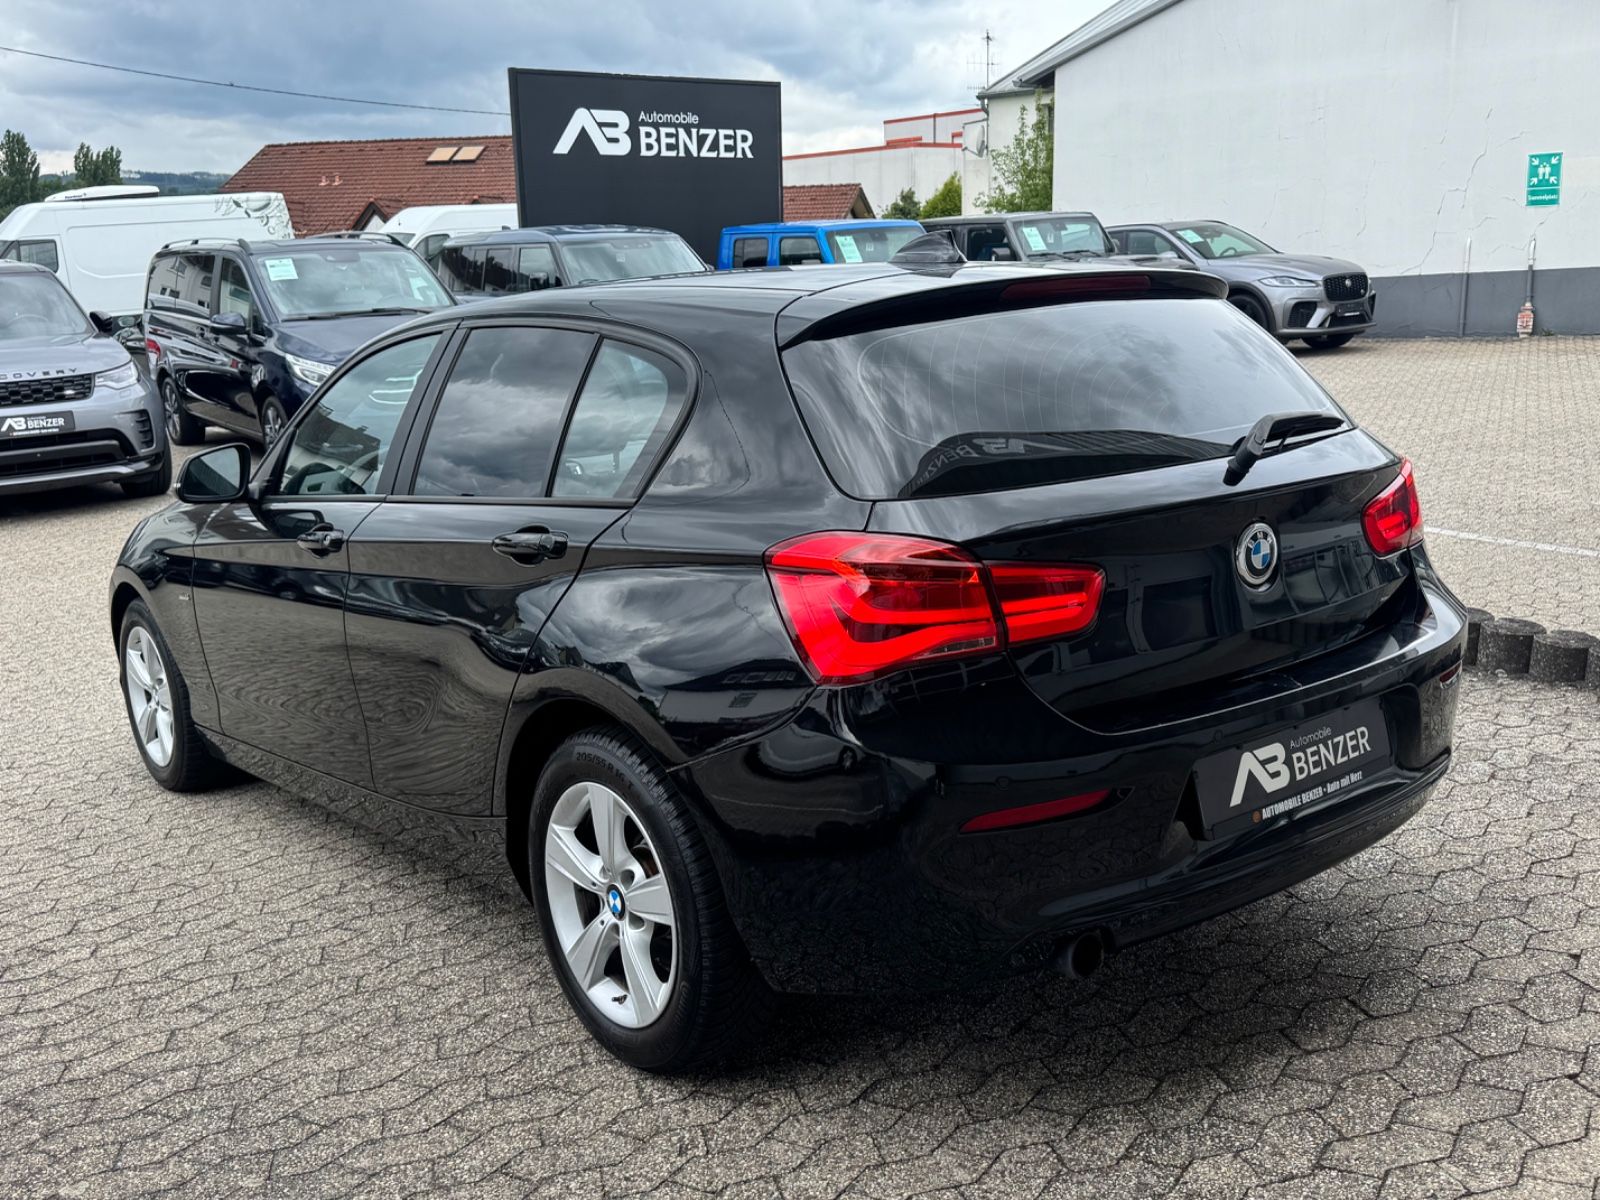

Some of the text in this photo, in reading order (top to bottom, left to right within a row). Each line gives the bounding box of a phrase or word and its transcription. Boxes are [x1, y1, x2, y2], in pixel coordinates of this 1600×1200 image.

[638, 111, 699, 124] Automobile
[638, 126, 754, 158] BENZER
[0, 368, 77, 380] COVERY
[27, 418, 65, 429] BENZER
[1290, 726, 1332, 750] Automobile
[576, 751, 606, 769] 205/55
[1291, 726, 1371, 781] BENZER
[1262, 795, 1302, 820] AUTOMOBILE
[1302, 787, 1324, 804] BENZER
